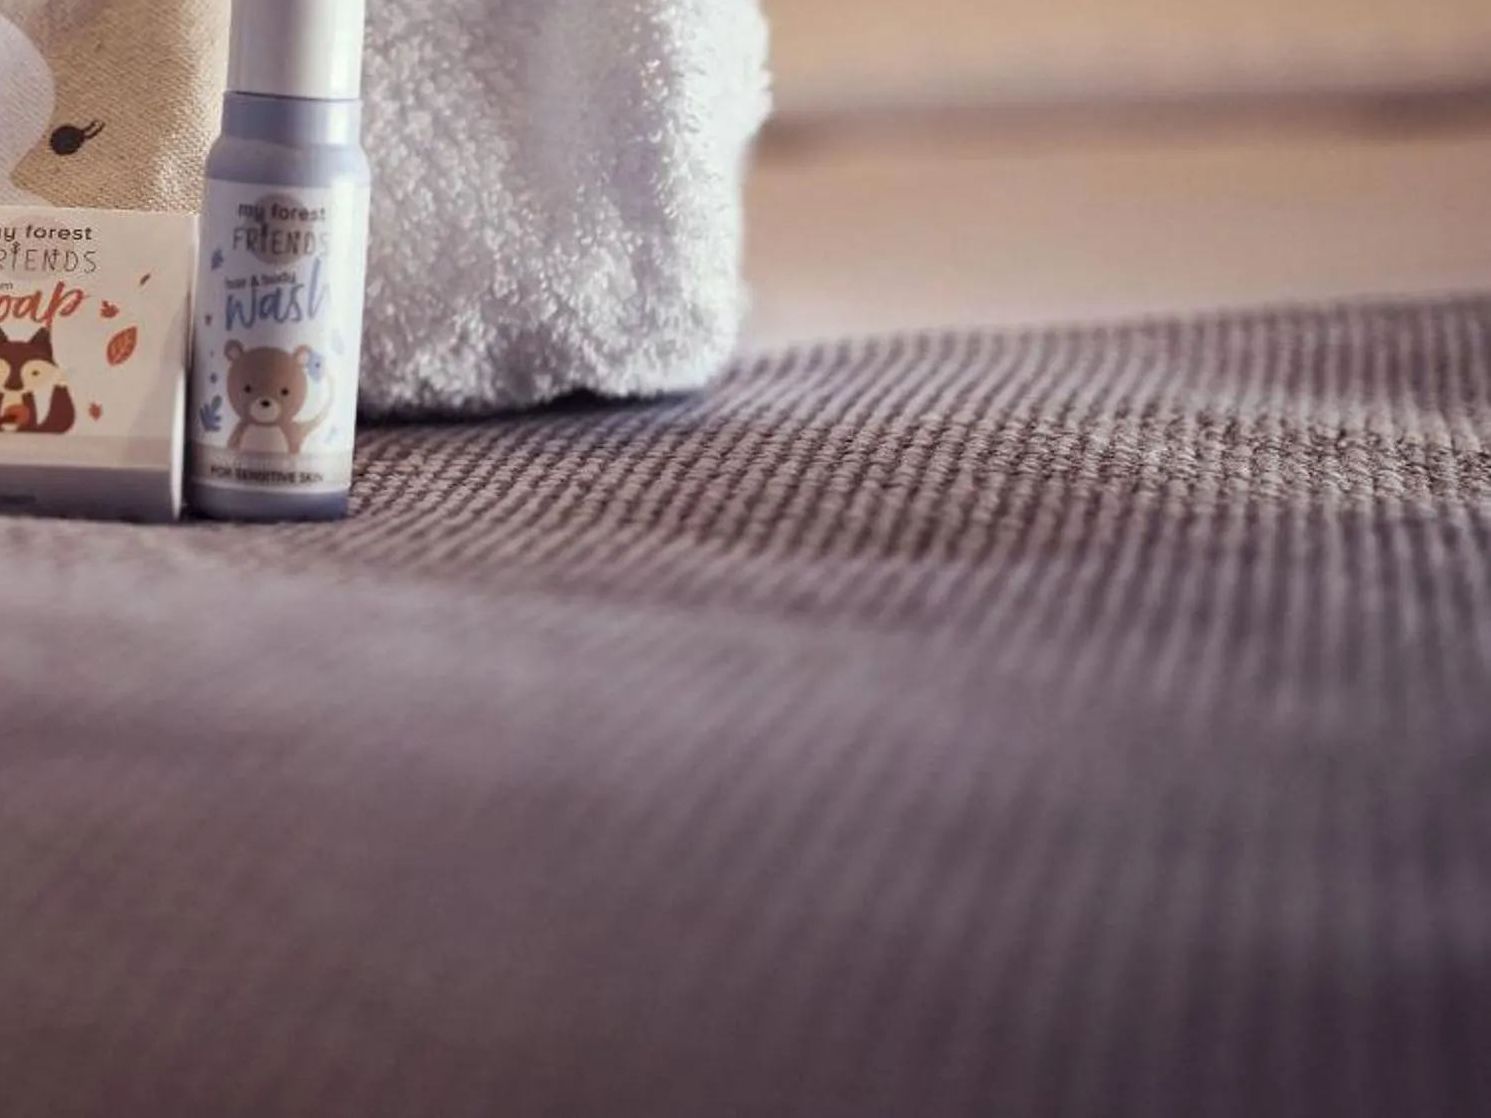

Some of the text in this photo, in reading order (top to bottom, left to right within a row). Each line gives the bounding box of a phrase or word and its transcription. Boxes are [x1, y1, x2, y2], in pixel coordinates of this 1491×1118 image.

[239, 203, 326, 222] my forest
[25, 225, 93, 240] forest
[233, 223, 330, 256] FRIENDS
[211, 466, 232, 477] FOR
[235, 468, 296, 483] SENSITIVE
